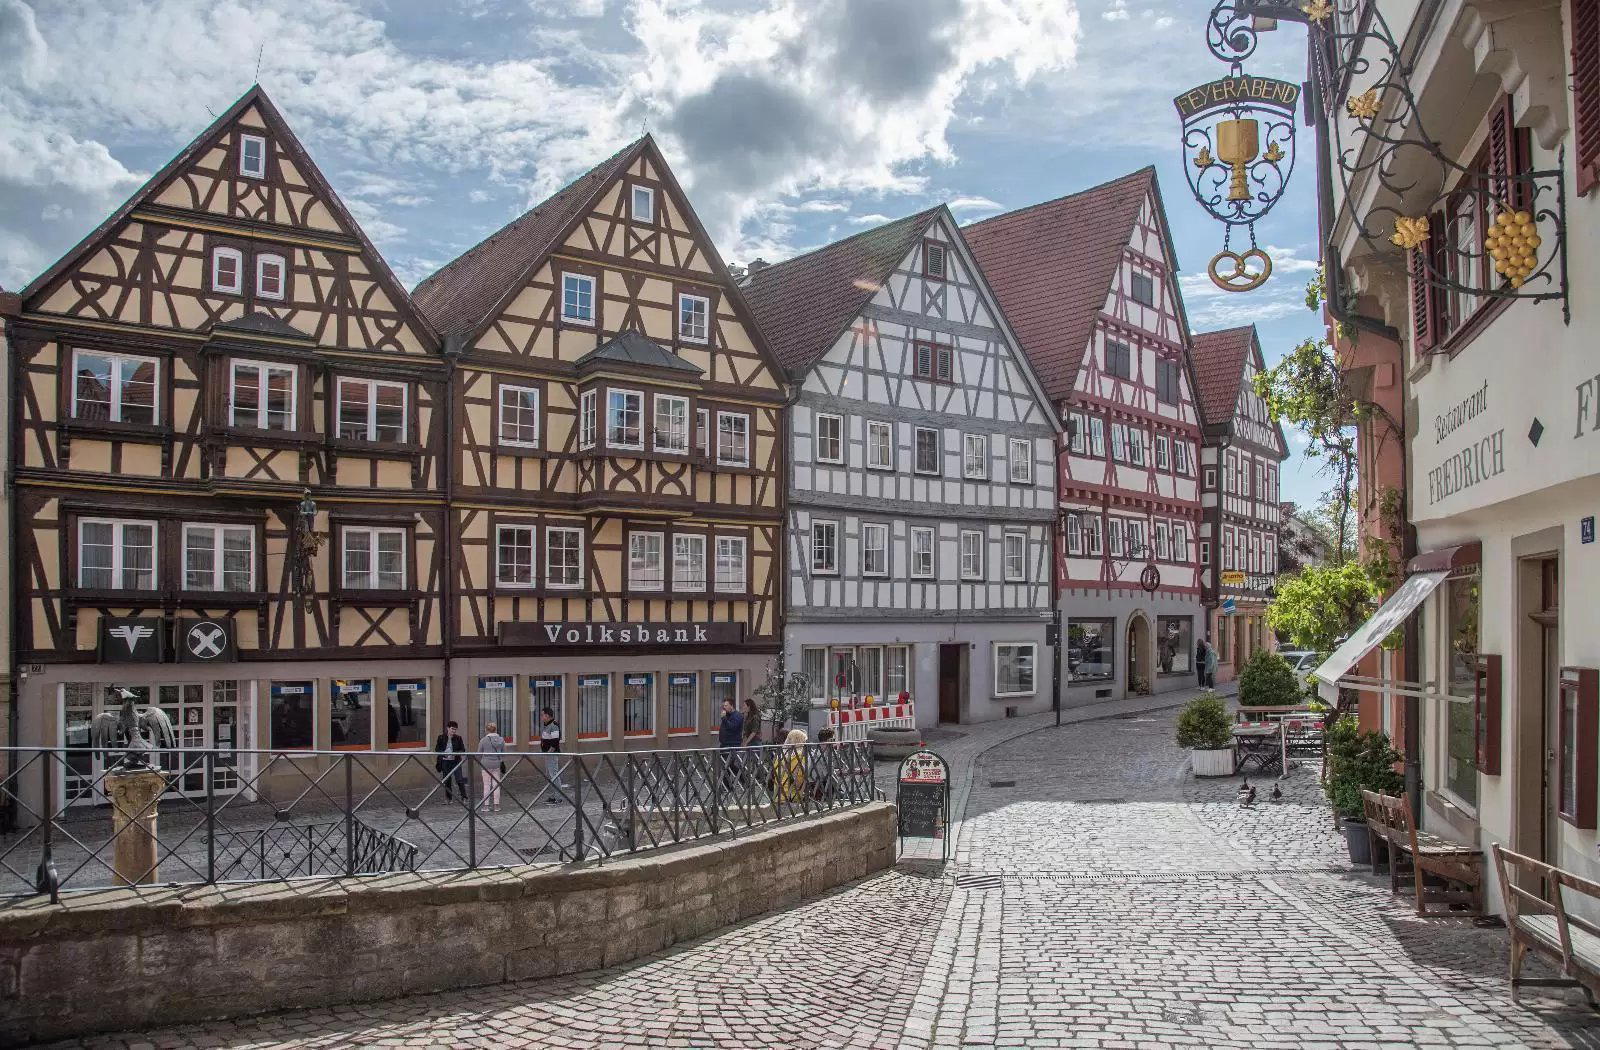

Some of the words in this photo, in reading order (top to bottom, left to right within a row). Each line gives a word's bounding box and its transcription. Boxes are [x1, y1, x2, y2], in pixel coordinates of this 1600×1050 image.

[1177, 79, 1297, 115] FEYERABEND
[1435, 378, 1488, 444] Restaurant
[544, 624, 707, 643] Volksbank
